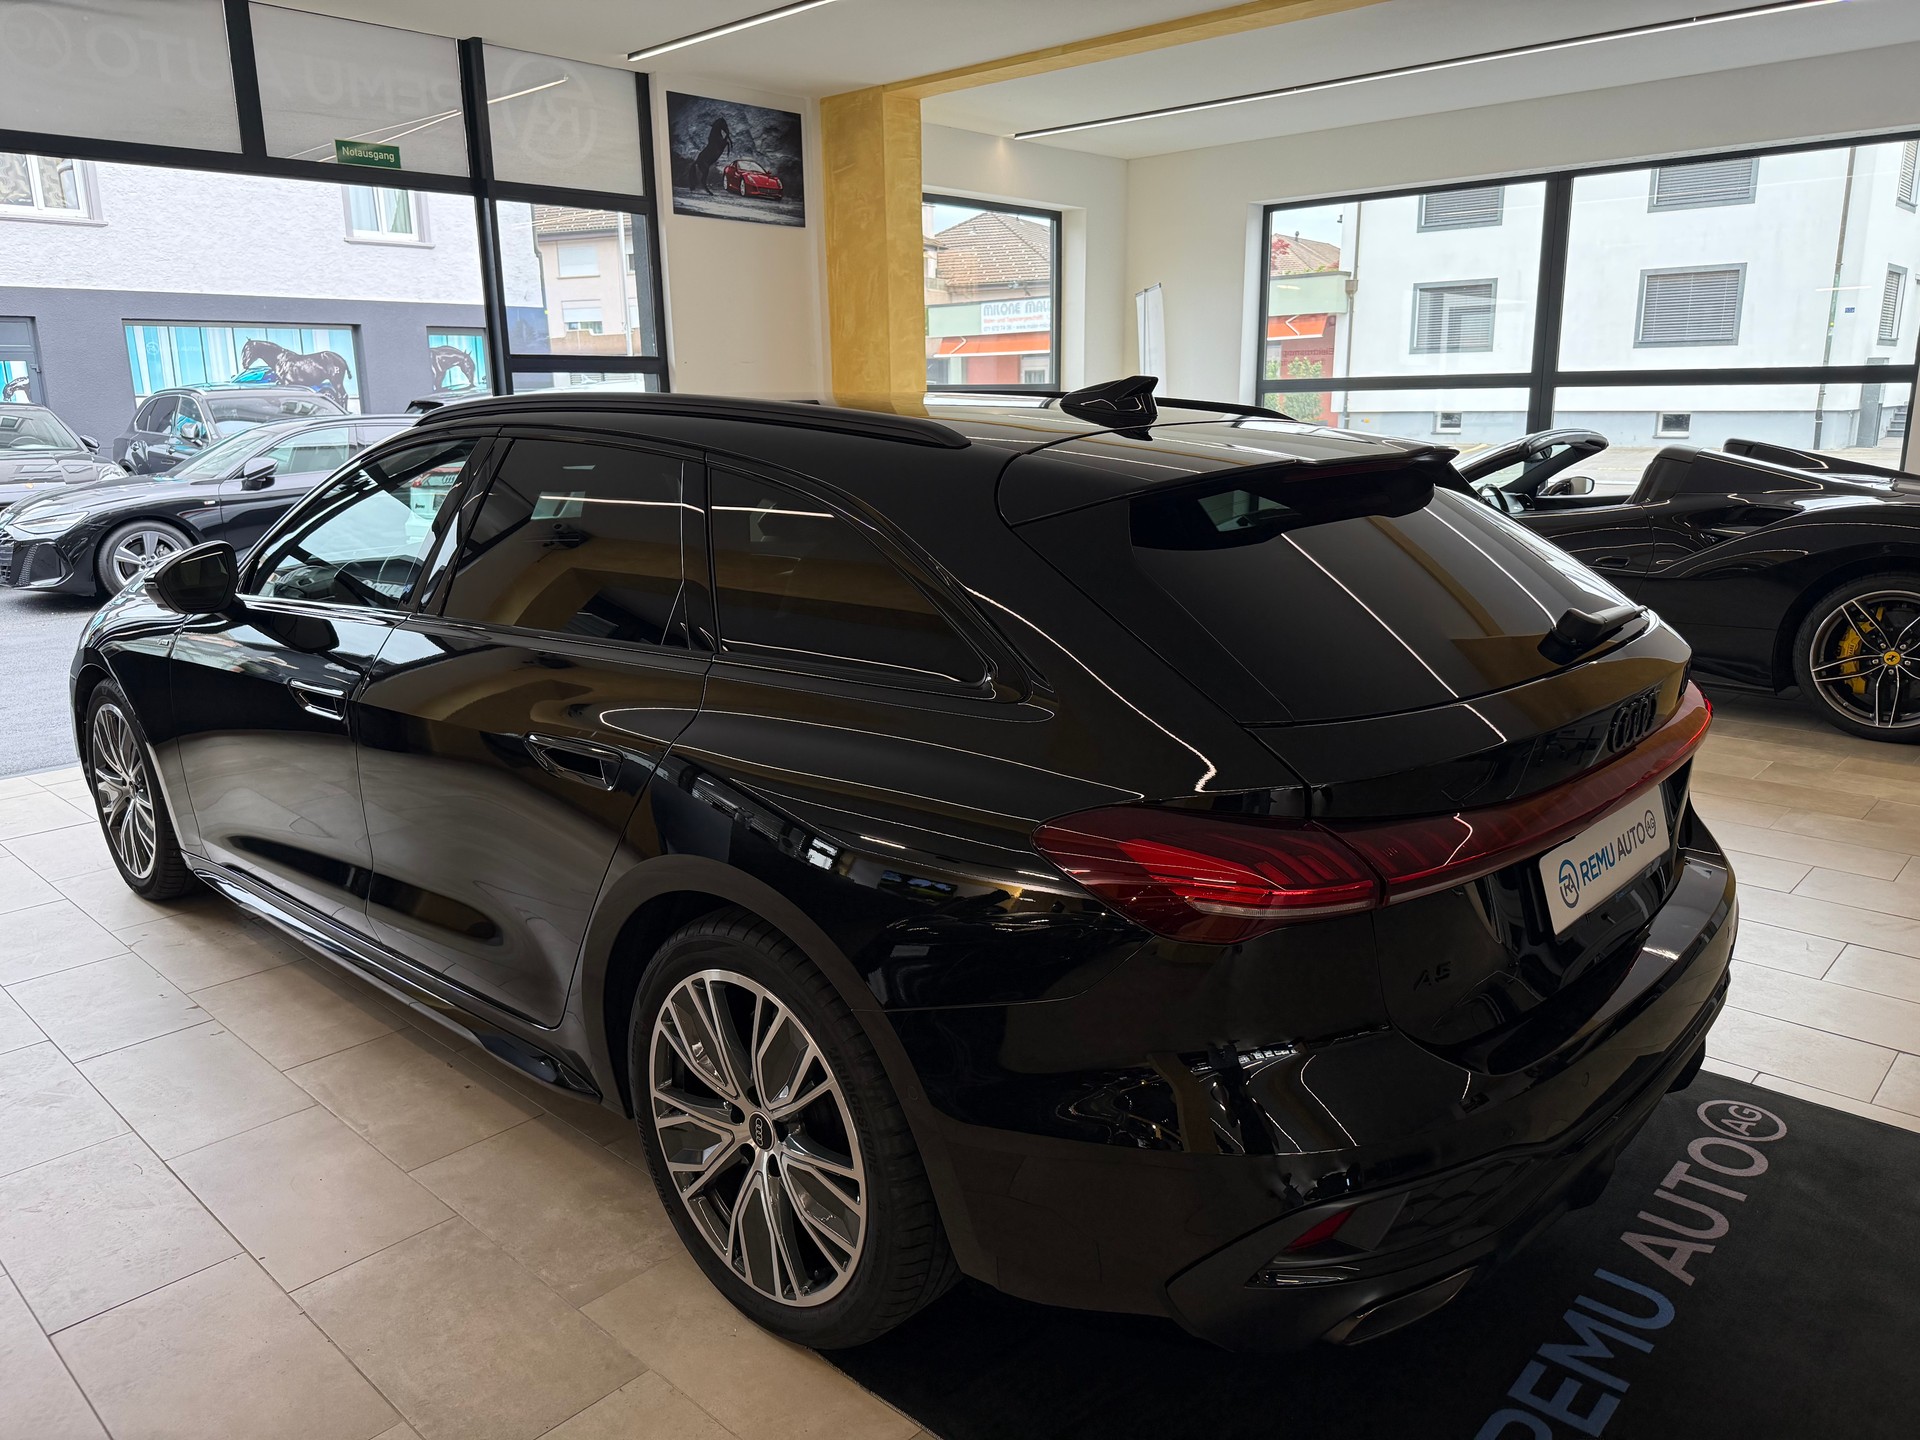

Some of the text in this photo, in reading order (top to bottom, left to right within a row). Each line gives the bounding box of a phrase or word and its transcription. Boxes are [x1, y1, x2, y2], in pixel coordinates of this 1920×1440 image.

[341, 146, 395, 163] Notausgang
[983, 302, 1021, 316] MILONE
[1580, 842, 1616, 886] REMU
[1617, 822, 1645, 861] AUTO
[1413, 961, 1451, 991] A5
[1620, 1137, 1769, 1286] AUTO
